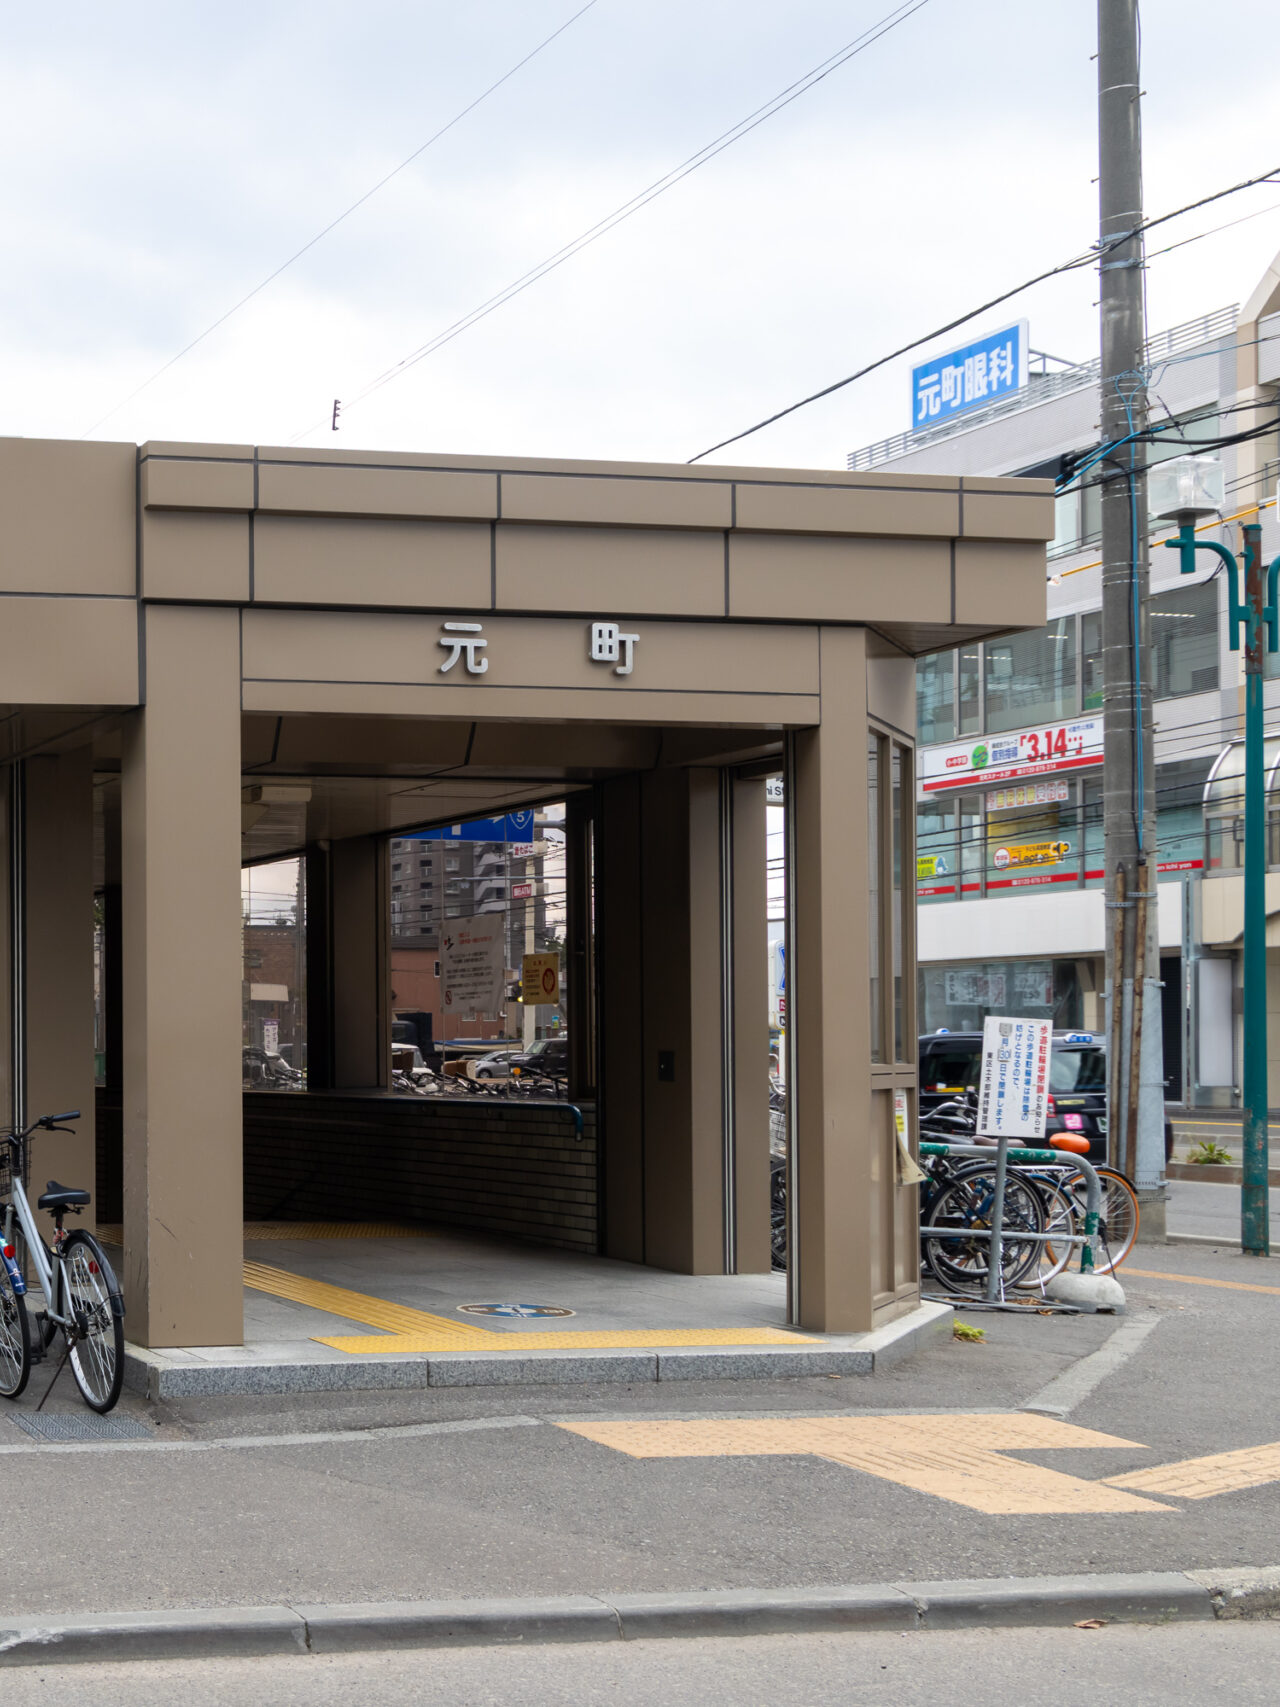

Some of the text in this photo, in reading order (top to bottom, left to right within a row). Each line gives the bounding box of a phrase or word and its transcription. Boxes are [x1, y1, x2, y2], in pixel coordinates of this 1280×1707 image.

[917, 341, 1014, 421] 元町眼科
[440, 622, 640, 674] 元町
[517, 812, 525, 823] 5
